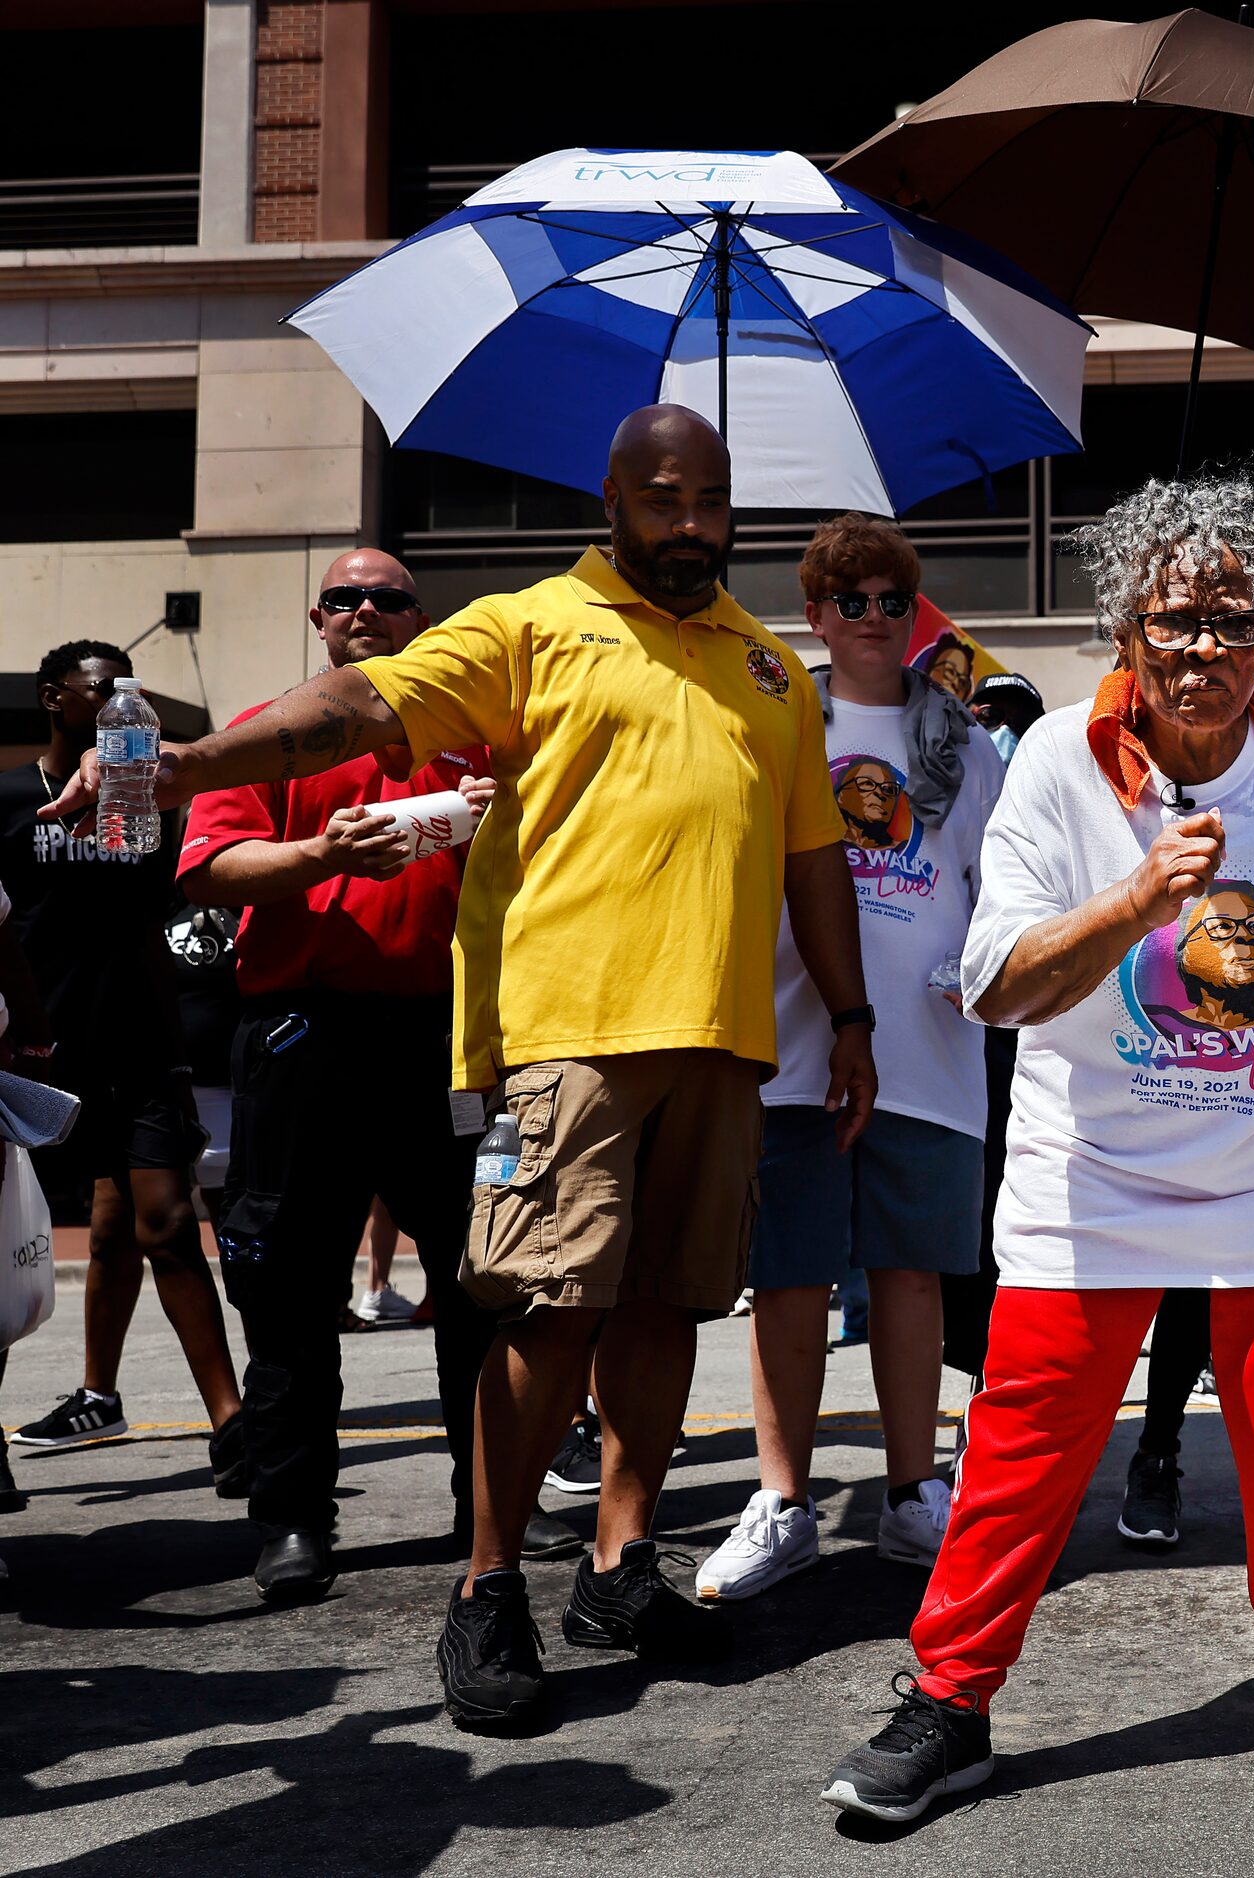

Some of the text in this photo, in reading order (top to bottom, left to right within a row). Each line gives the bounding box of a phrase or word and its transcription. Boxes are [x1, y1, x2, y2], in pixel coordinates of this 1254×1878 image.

[574, 167, 716, 182] trwd
[597, 634, 621, 645] Jones
[756, 685, 788, 705] MARYLAND
[865, 849, 928, 878] WALK
[877, 861, 940, 900] Live!
[864, 899, 907, 915] WASHINGTON
[907, 910, 916, 918] DC
[869, 907, 882, 915] LOS
[883, 911, 912, 923] ANGELES
[1110, 1029, 1225, 1060] OPAL'S
[1131, 1072, 1240, 1093] JUNE 19, 2021
[1130, 1088, 1156, 1097] FORT
[1158, 1091, 1194, 1102] WORTH
[1201, 1096, 1221, 1104] NYC
[1138, 1097, 1180, 1109] ATLANTA
[1188, 1103, 1230, 1113] DETROIT
[1236, 1106, 1253, 1116] LOS
